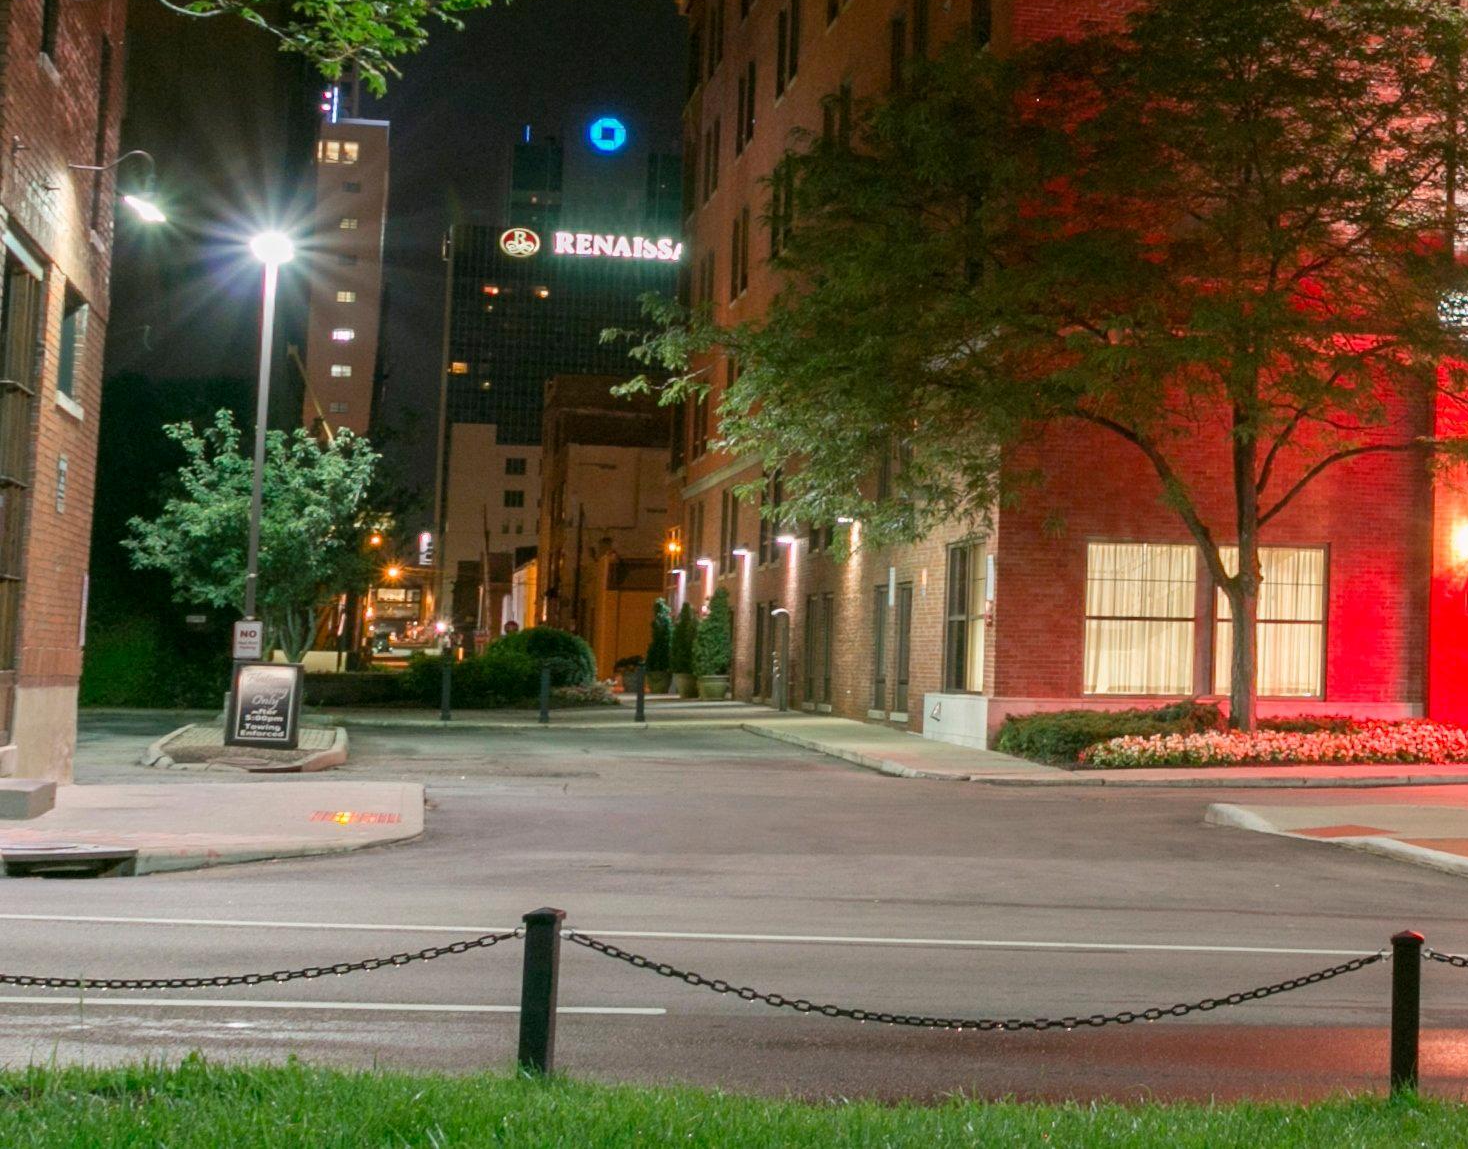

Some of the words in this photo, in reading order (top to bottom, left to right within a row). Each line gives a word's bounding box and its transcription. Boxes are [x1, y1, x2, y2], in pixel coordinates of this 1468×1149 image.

[240, 630, 257, 638] NO
[251, 694, 279, 710] Only
[243, 722, 282, 732] Towing
[240, 729, 285, 738] Enforced
